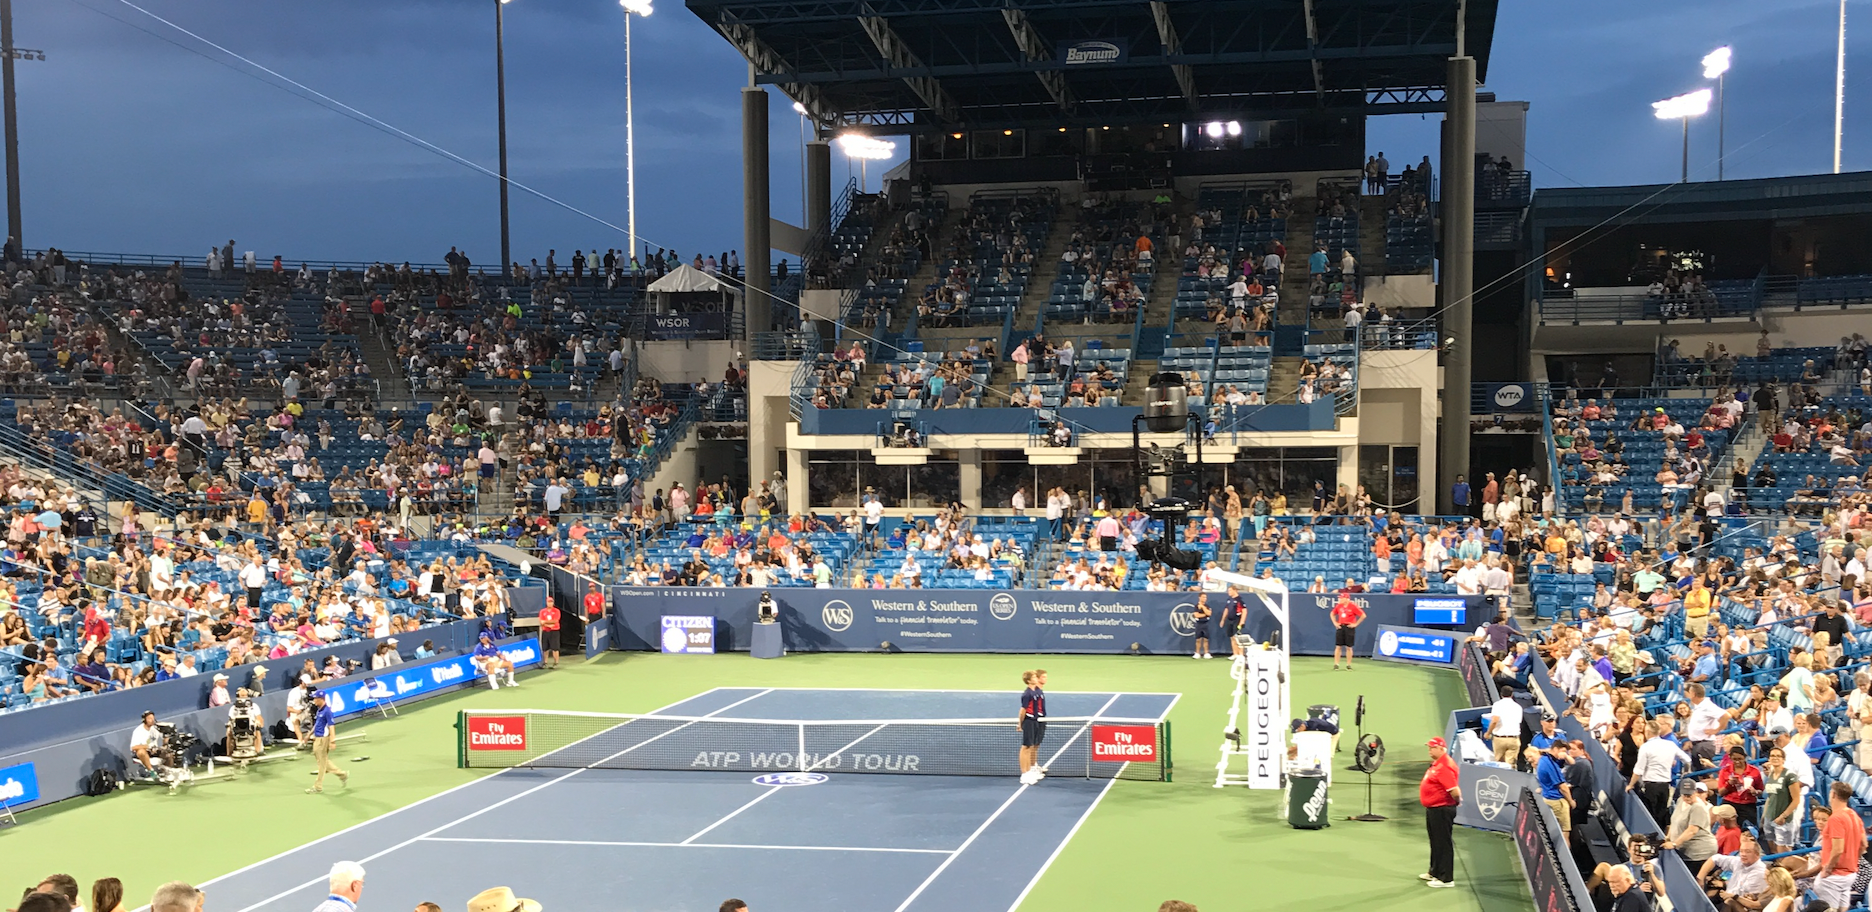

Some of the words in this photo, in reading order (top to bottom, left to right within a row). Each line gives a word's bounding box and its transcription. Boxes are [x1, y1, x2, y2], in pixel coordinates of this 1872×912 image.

[1066, 48, 1118, 62] Baynum
[655, 318, 690, 327] WSOR
[1496, 416, 1502, 424] 7
[131, 443, 140, 454] 11
[871, 599, 915, 611] Western
[916, 600, 928, 611] &
[929, 600, 978, 612] Southern
[1031, 600, 1076, 613] Western
[1077, 601, 1089, 613] &
[1091, 601, 1142, 614] Southern
[1331, 597, 1370, 608] Hlth
[661, 615, 713, 628] CITIZEN
[824, 608, 851, 625] W&S
[900, 615, 926, 626] financial
[960, 617, 978, 625] today.
[1034, 617, 1047, 625] Talk
[1060, 616, 1087, 627] financial
[1122, 619, 1142, 627] today.
[687, 632, 711, 644] 1:07
[900, 630, 952, 638] #WesternSouthern
[1060, 632, 1114, 640] #WesternSouthern
[1257, 662, 1269, 778] PEUGEOT
[488, 722, 505, 734] Fly
[471, 731, 523, 745] Emirates
[1114, 731, 1132, 744] Fly
[1095, 741, 1153, 756] Emirates
[690, 751, 740, 768] ATP
[750, 752, 842, 769] WORLD
[852, 753, 921, 771] TOUR
[1478, 789, 1505, 799] OPEN
